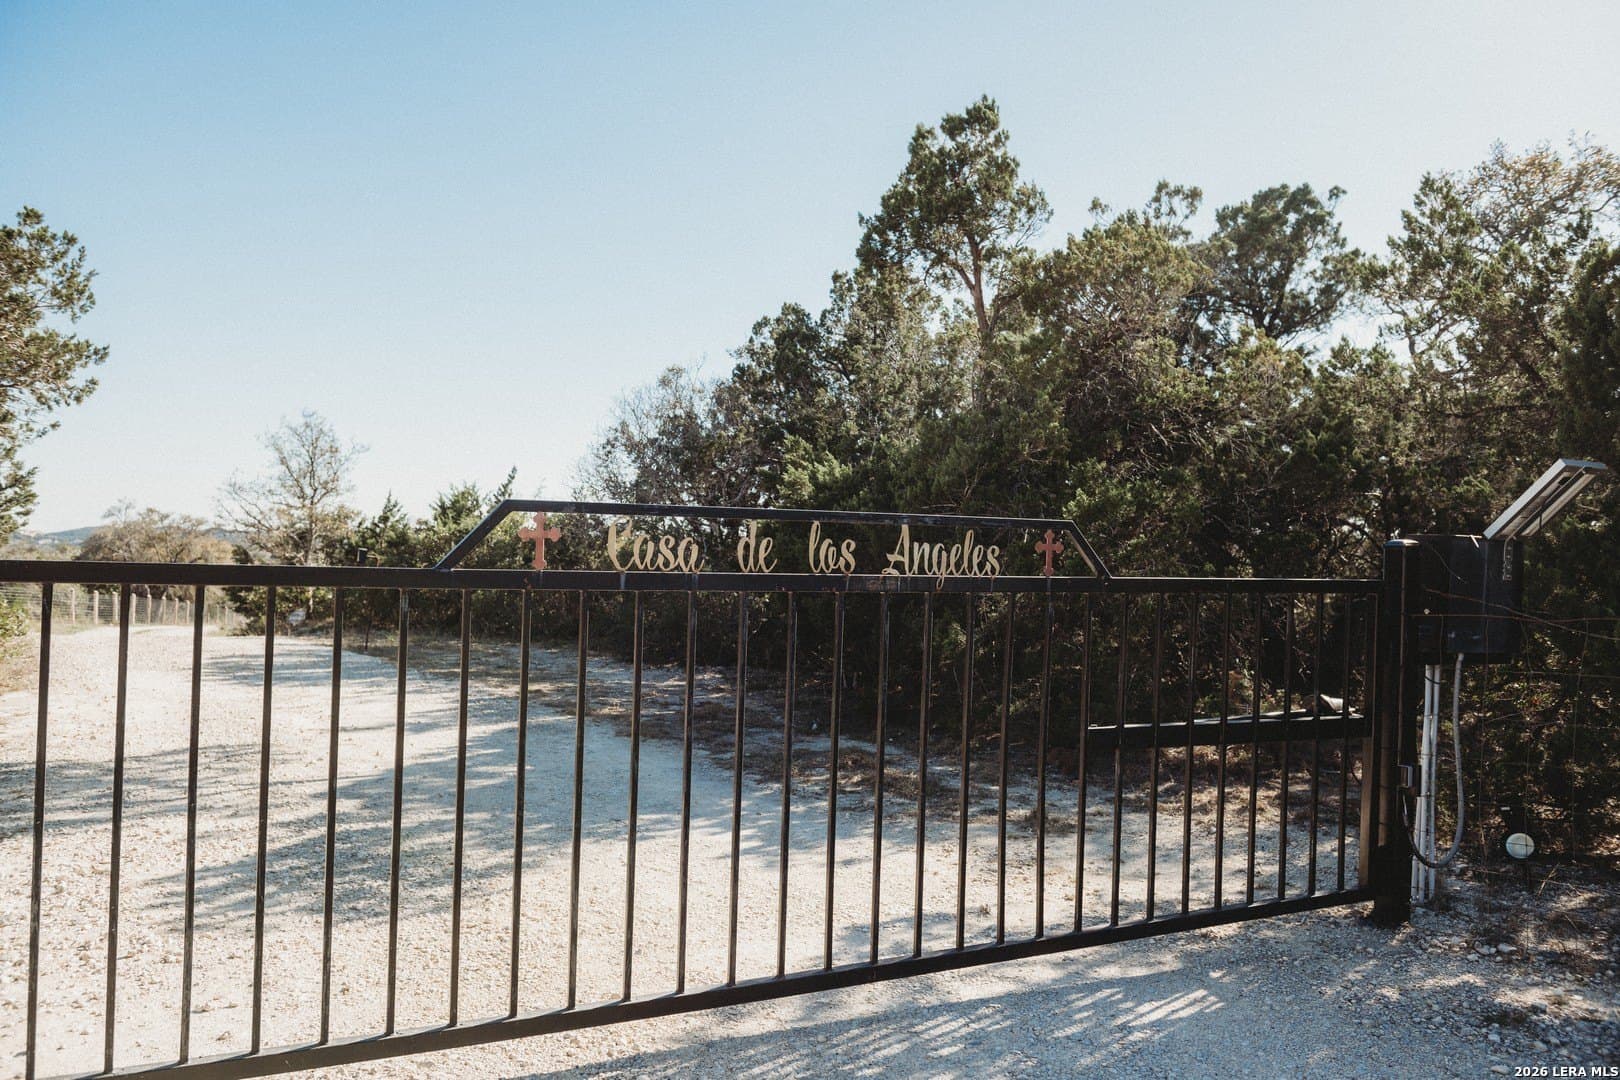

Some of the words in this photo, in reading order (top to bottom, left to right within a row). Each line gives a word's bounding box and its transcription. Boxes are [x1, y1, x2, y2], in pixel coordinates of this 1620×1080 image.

[607, 516, 705, 573] Casa
[737, 519, 778, 573] de
[808, 520, 856, 575] los
[881, 524, 1000, 590] Angeles
